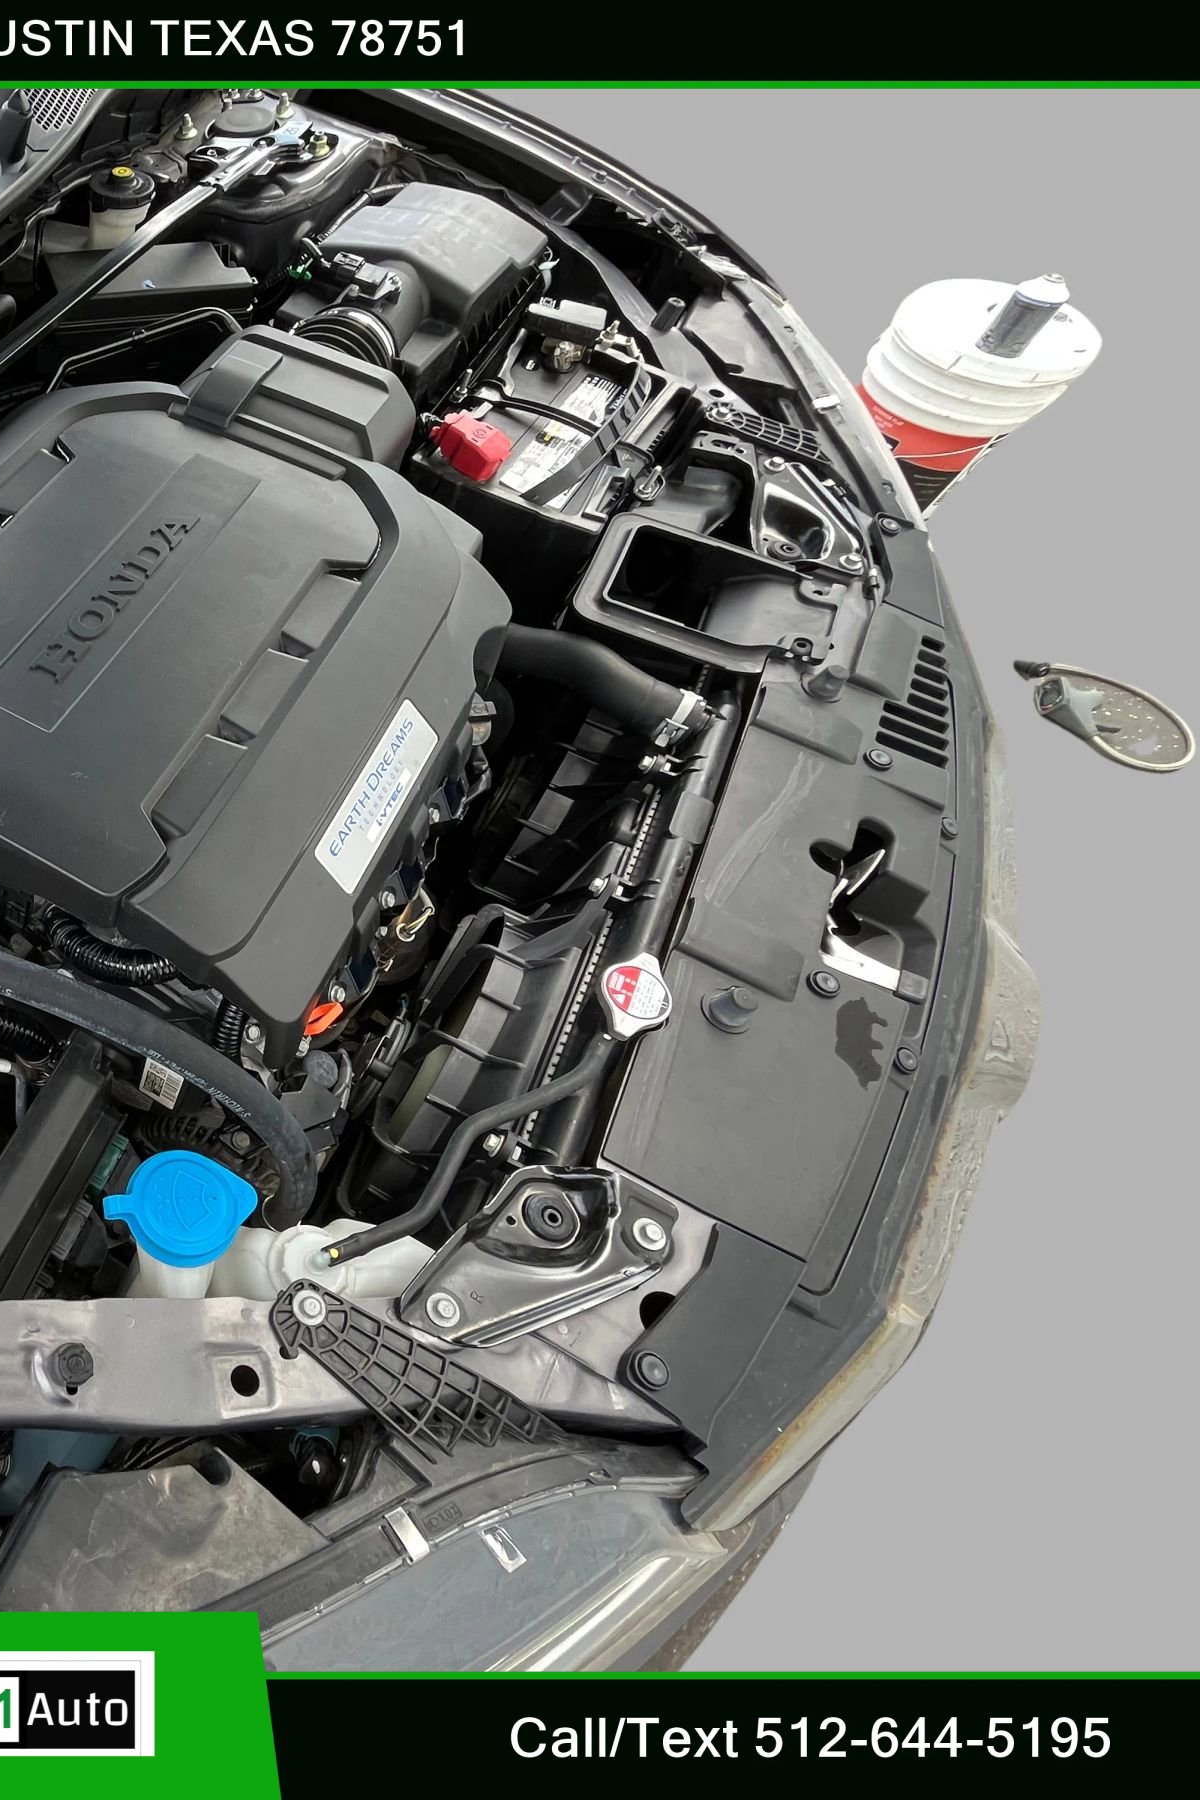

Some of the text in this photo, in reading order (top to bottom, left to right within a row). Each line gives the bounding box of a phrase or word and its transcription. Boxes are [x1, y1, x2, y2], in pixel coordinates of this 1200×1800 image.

[30, 516, 201, 684] HONDA
[329, 717, 414, 857] EARTH DREAMS
